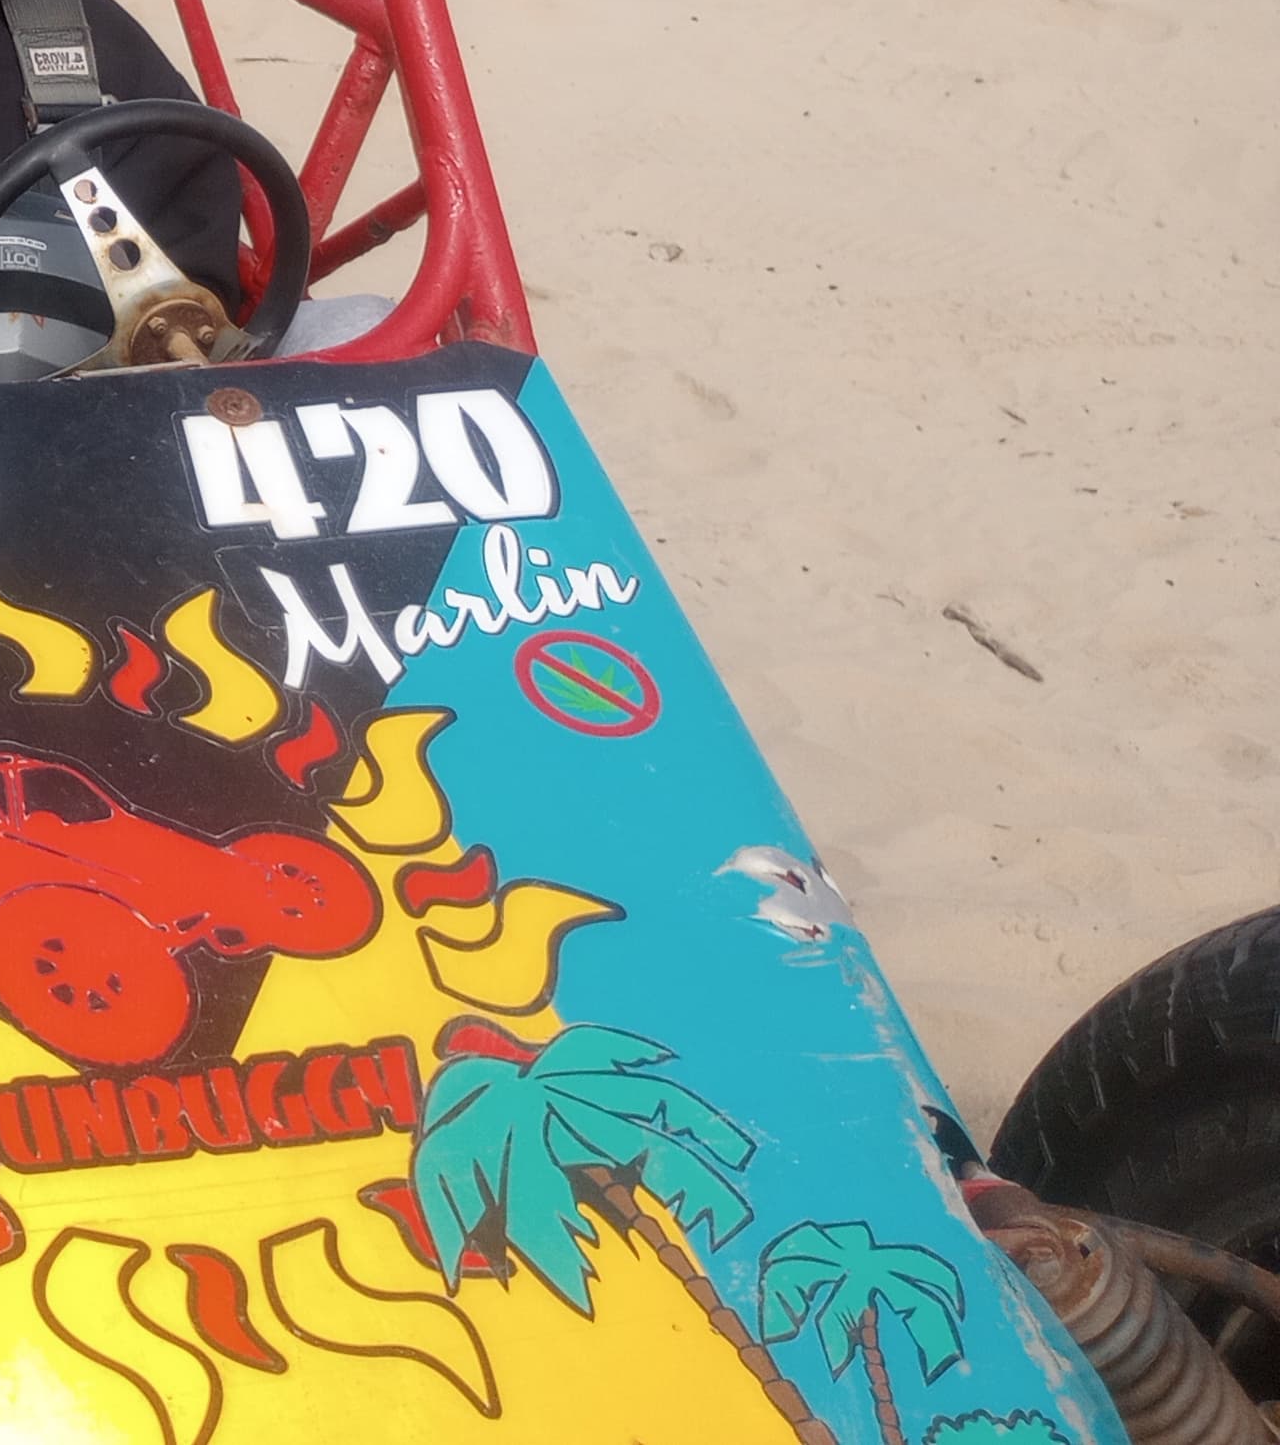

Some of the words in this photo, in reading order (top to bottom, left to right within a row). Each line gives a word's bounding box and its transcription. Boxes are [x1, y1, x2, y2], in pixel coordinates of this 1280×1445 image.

[34, 52, 70, 65] CROW
[2, 249, 39, 267] DOT
[181, 388, 556, 541] 420
[259, 524, 640, 690] Marlin
